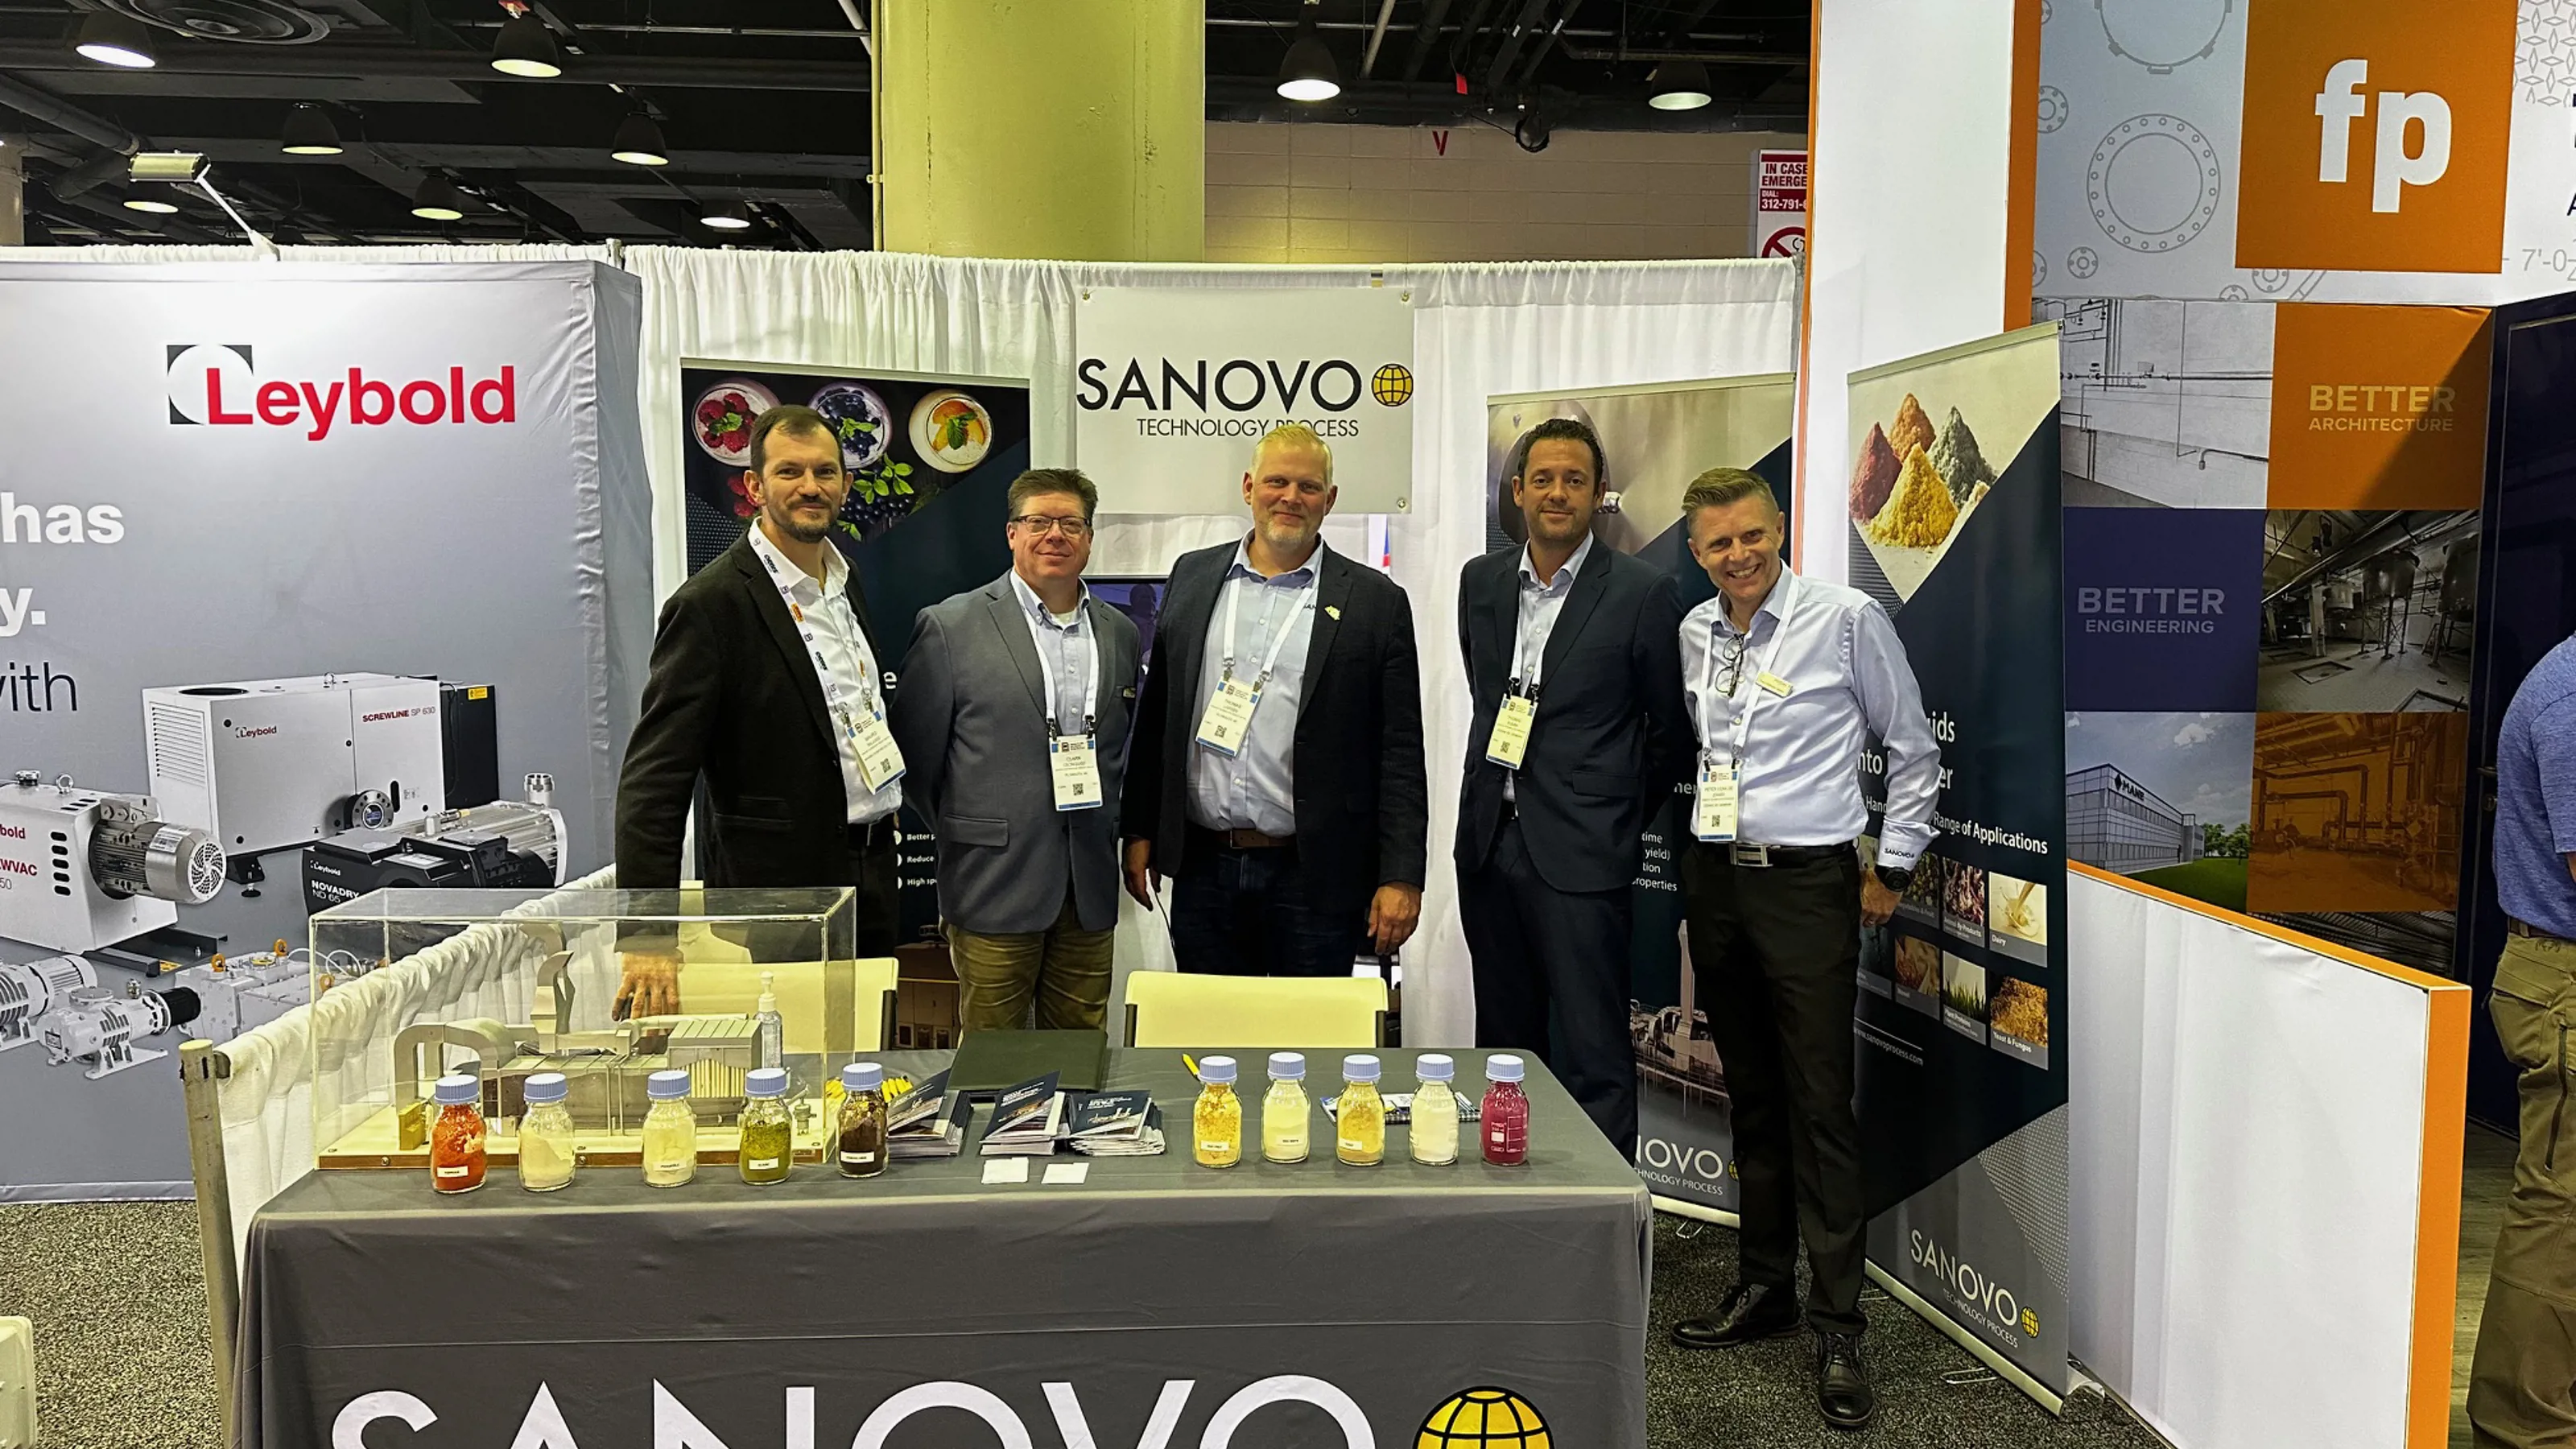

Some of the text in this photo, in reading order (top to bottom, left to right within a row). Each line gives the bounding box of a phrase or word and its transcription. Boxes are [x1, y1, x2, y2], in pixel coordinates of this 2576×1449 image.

[2315, 59, 2452, 213] fp
[1765, 163, 1807, 175] IN CASE
[1761, 175, 1806, 187] EMERGE
[1761, 190, 1779, 198] DIAL:
[1075, 357, 1362, 414] SANOVO
[206, 365, 516, 441] Leybold
[2309, 385, 2455, 413] BETTER
[1137, 418, 1269, 437] TECHNOLOGY
[2308, 417, 2454, 433] ARCHITECTURE
[0, 492, 125, 544] has
[2077, 587, 2226, 615] BETTER
[2085, 618, 2215, 634] ENGINEERING
[362, 706, 436, 723] SCREWLINE SP 630
[240, 725, 277, 738] Leybold
[1927, 711, 1956, 743] ids
[906, 833, 930, 841] Better
[1934, 811, 2049, 855] Range of Applications
[906, 854, 935, 864] Reduce
[1645, 848, 1671, 861] yield)
[311, 879, 360, 899] NOVADRY
[906, 877, 926, 887] High
[312, 889, 341, 904] ND 65
[1992, 934, 2006, 947] Dairy
[1992, 1030, 2007, 1043] Yeast
[2007, 1036, 2012, 1045] &
[1633, 1166, 1724, 1196] HNOLOGY PROCESS
[1910, 1228, 2018, 1326] SANOVO
[1942, 1287, 2019, 1349] TECHNOLOGY PROCESS
